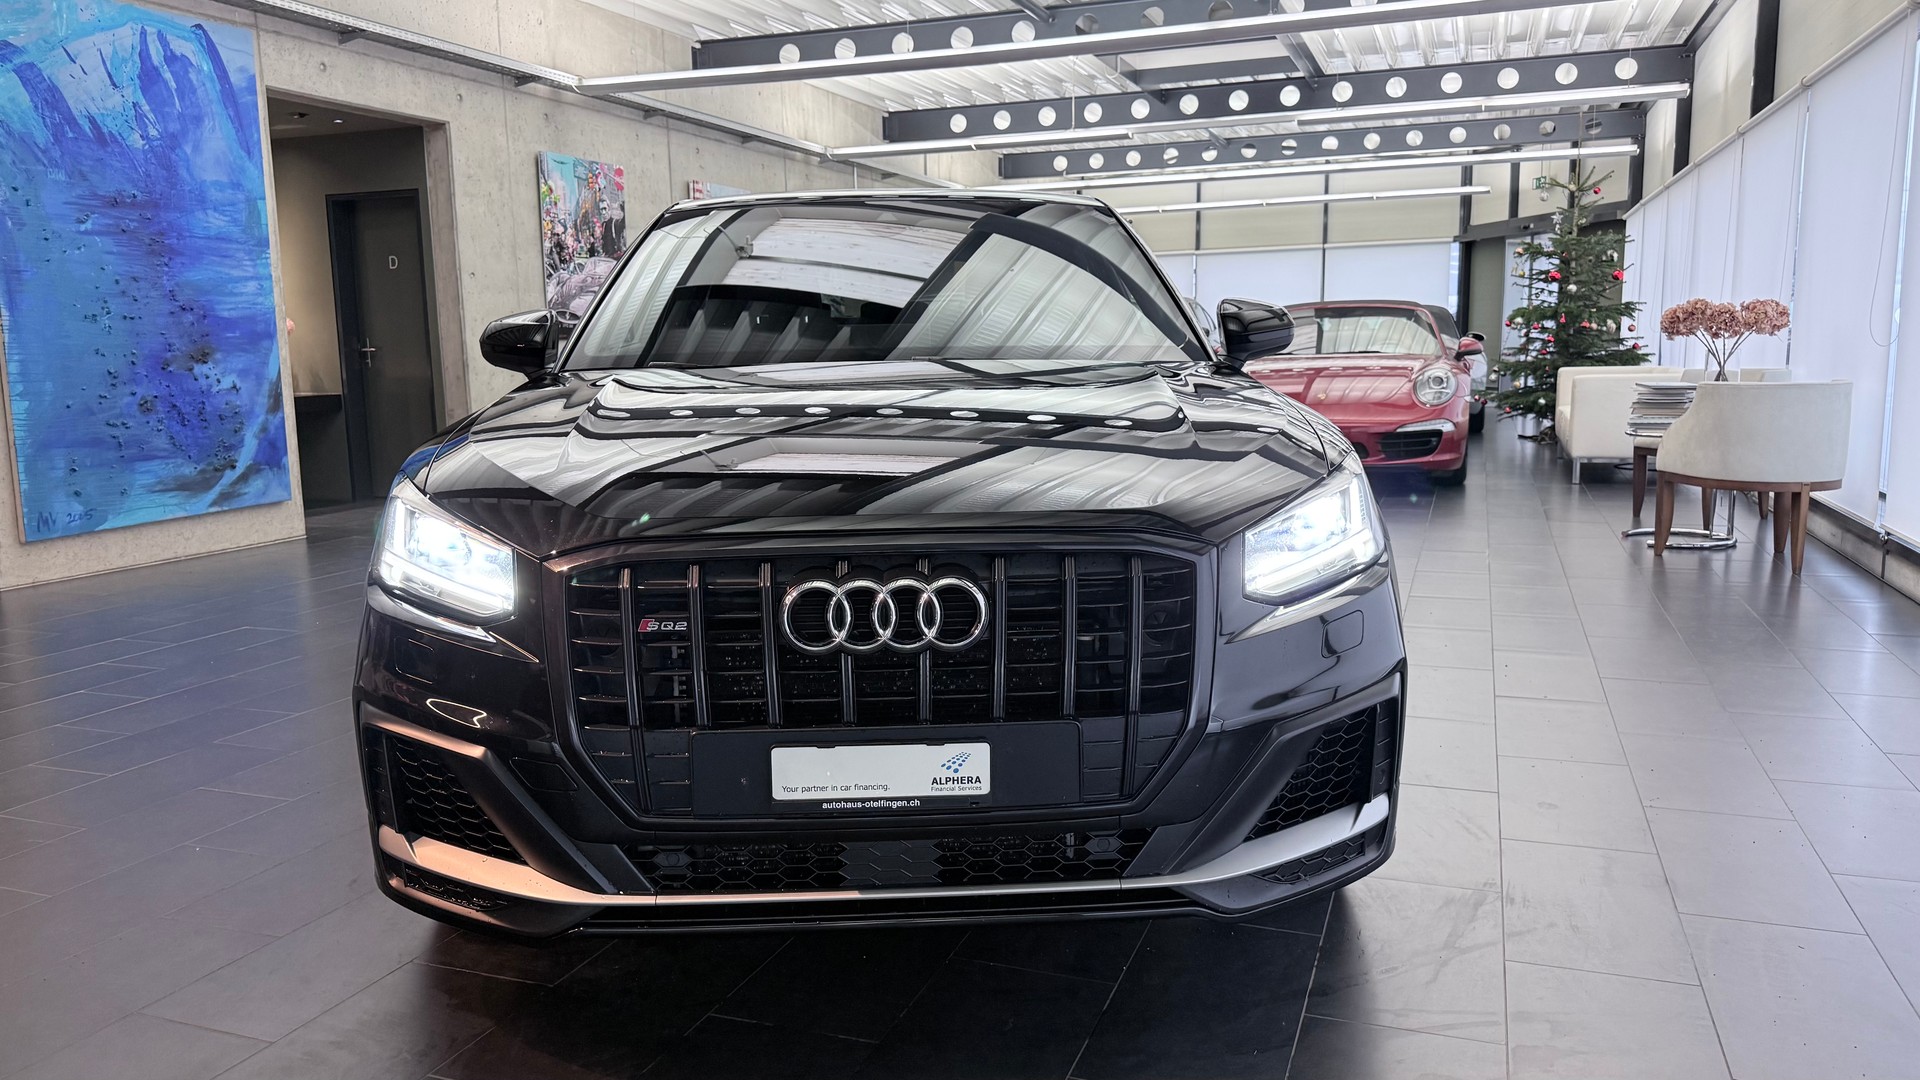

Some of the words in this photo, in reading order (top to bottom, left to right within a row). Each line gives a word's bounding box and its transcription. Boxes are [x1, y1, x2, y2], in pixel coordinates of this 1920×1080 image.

[388, 255, 398, 269] D
[646, 621, 688, 631] SQ2
[931, 776, 982, 785] ALPHERA
[782, 785, 799, 793] Your
[801, 785, 829, 794] partner
[854, 783, 890, 791] financing.
[822, 799, 920, 809] autohaus-otelfingen.ch
